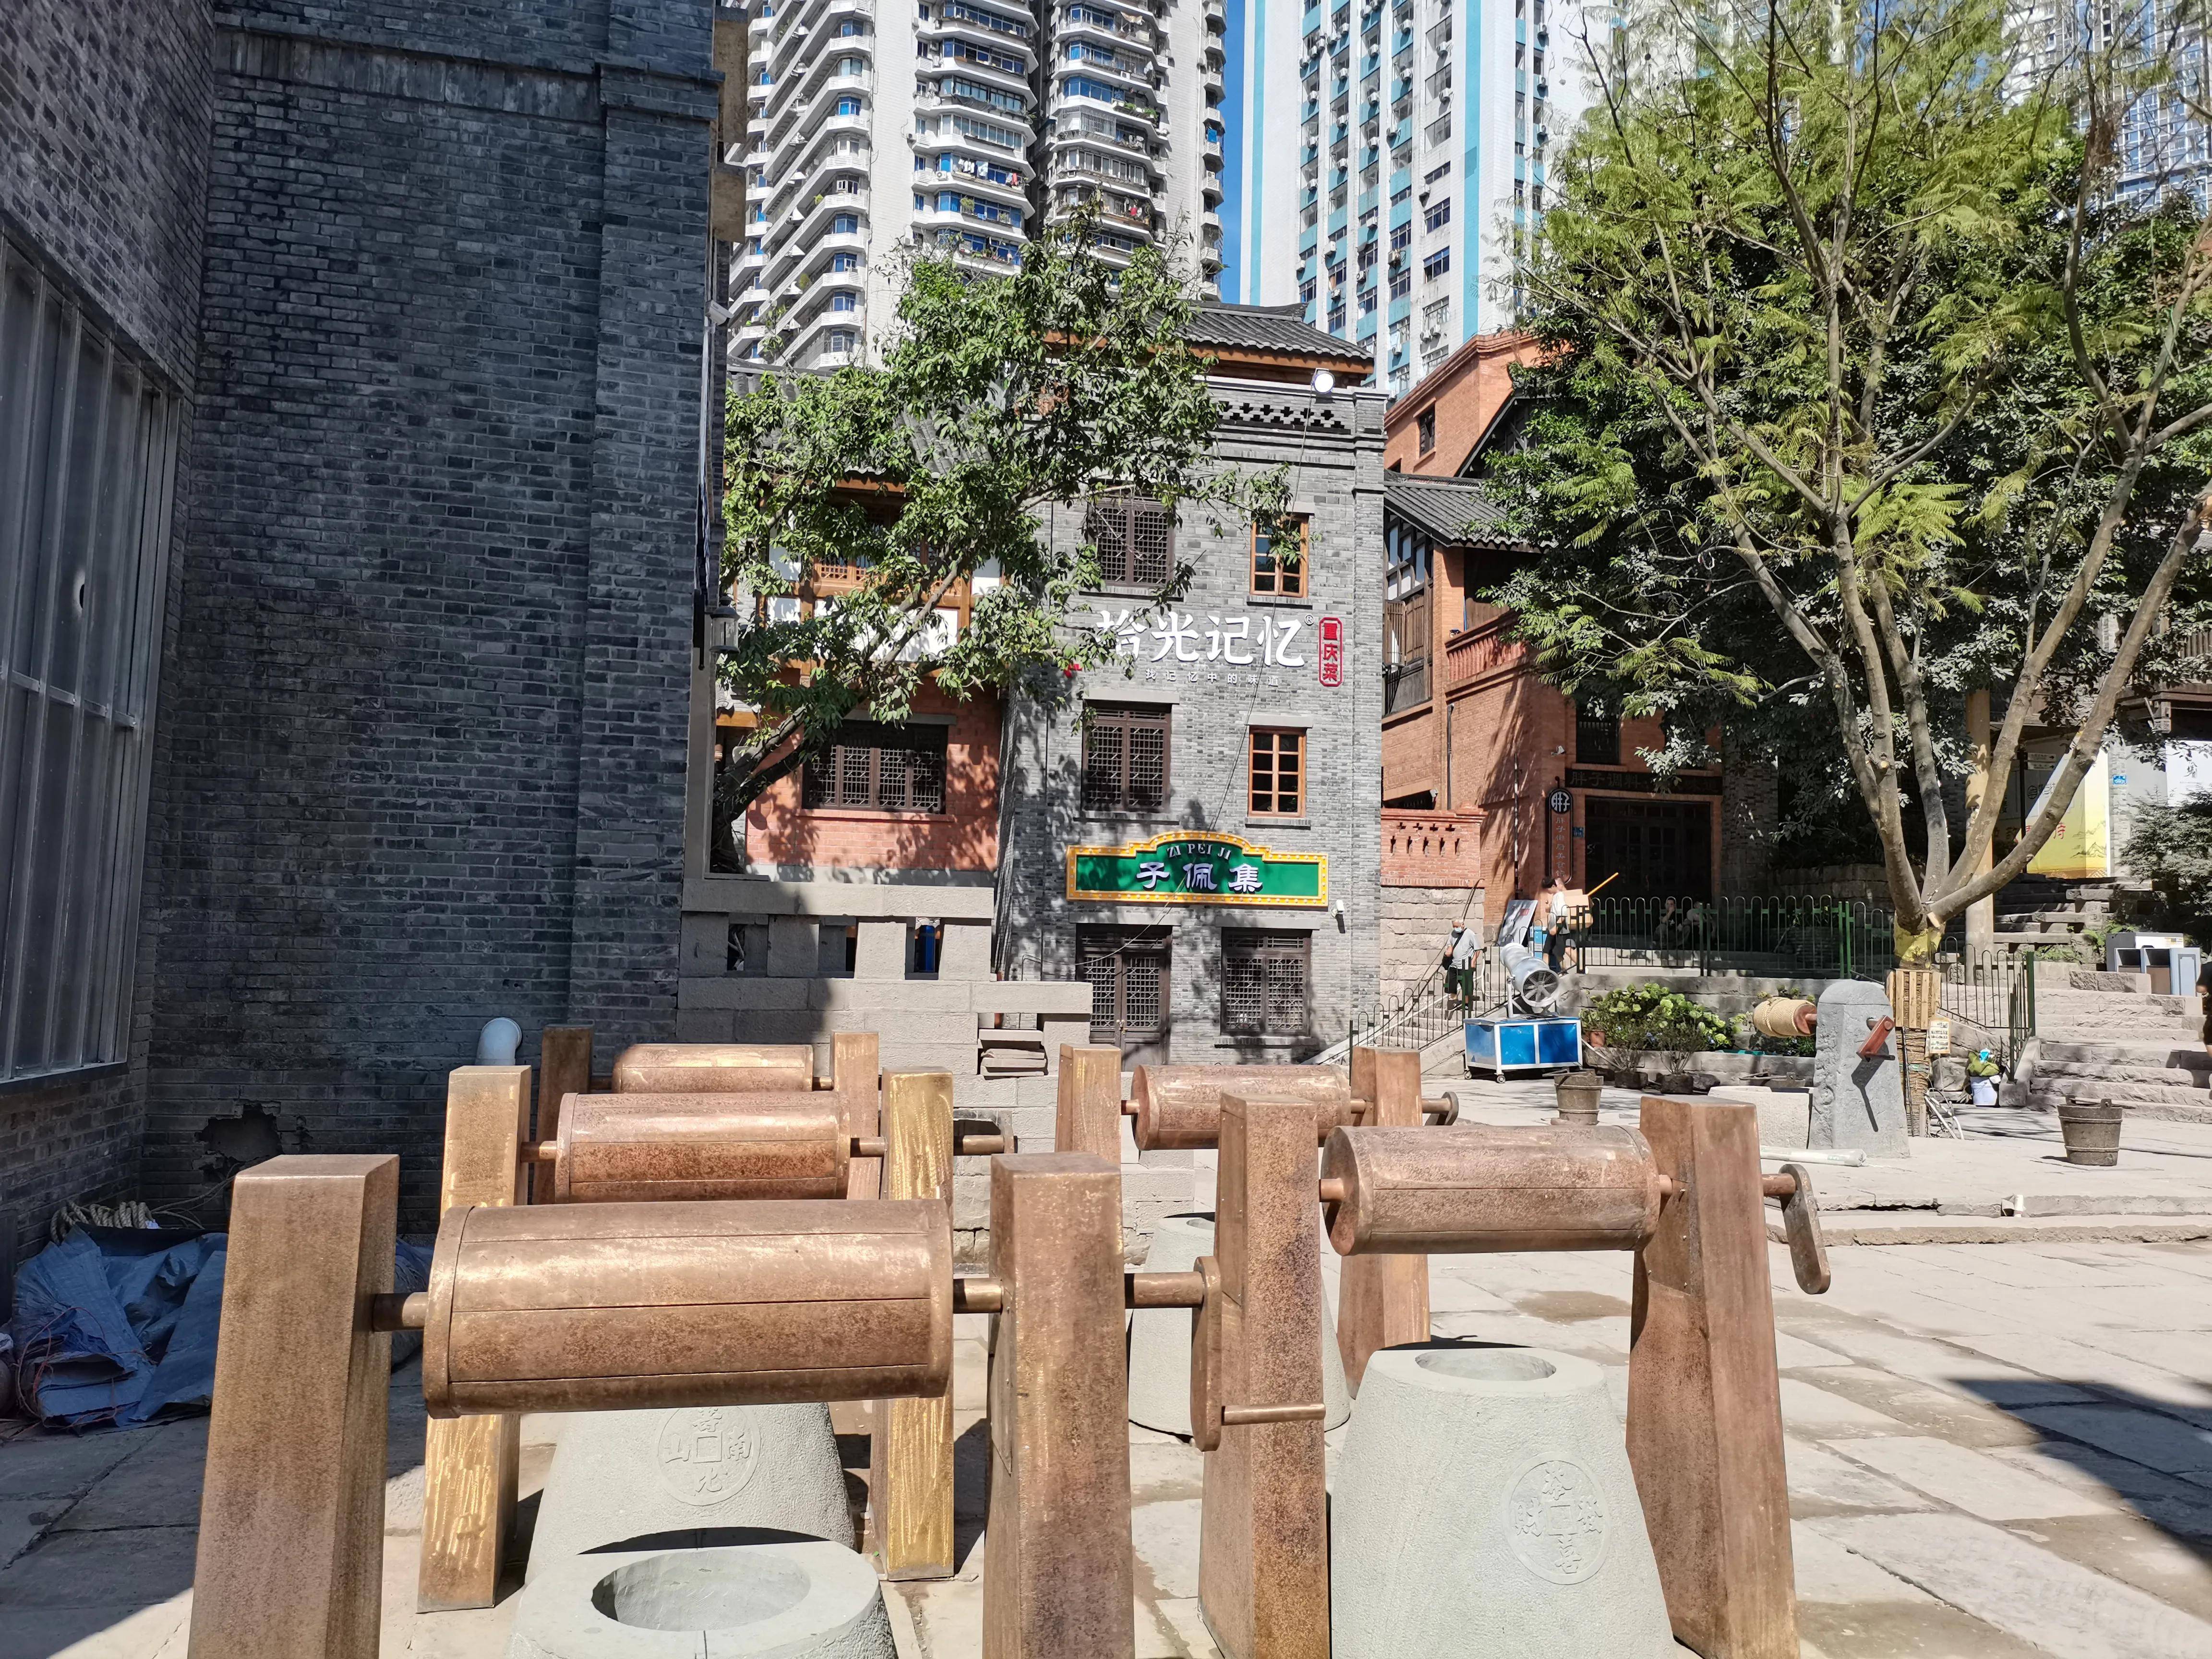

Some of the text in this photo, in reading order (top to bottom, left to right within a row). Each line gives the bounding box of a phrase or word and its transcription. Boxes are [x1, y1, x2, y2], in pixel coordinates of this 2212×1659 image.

[1095, 609, 1305, 667] 拾光记忆
[1323, 622, 1338, 682] 重庆菜
[1167, 843, 1232, 860] ZI PEI JI
[1136, 861, 1263, 893] 子佩集
